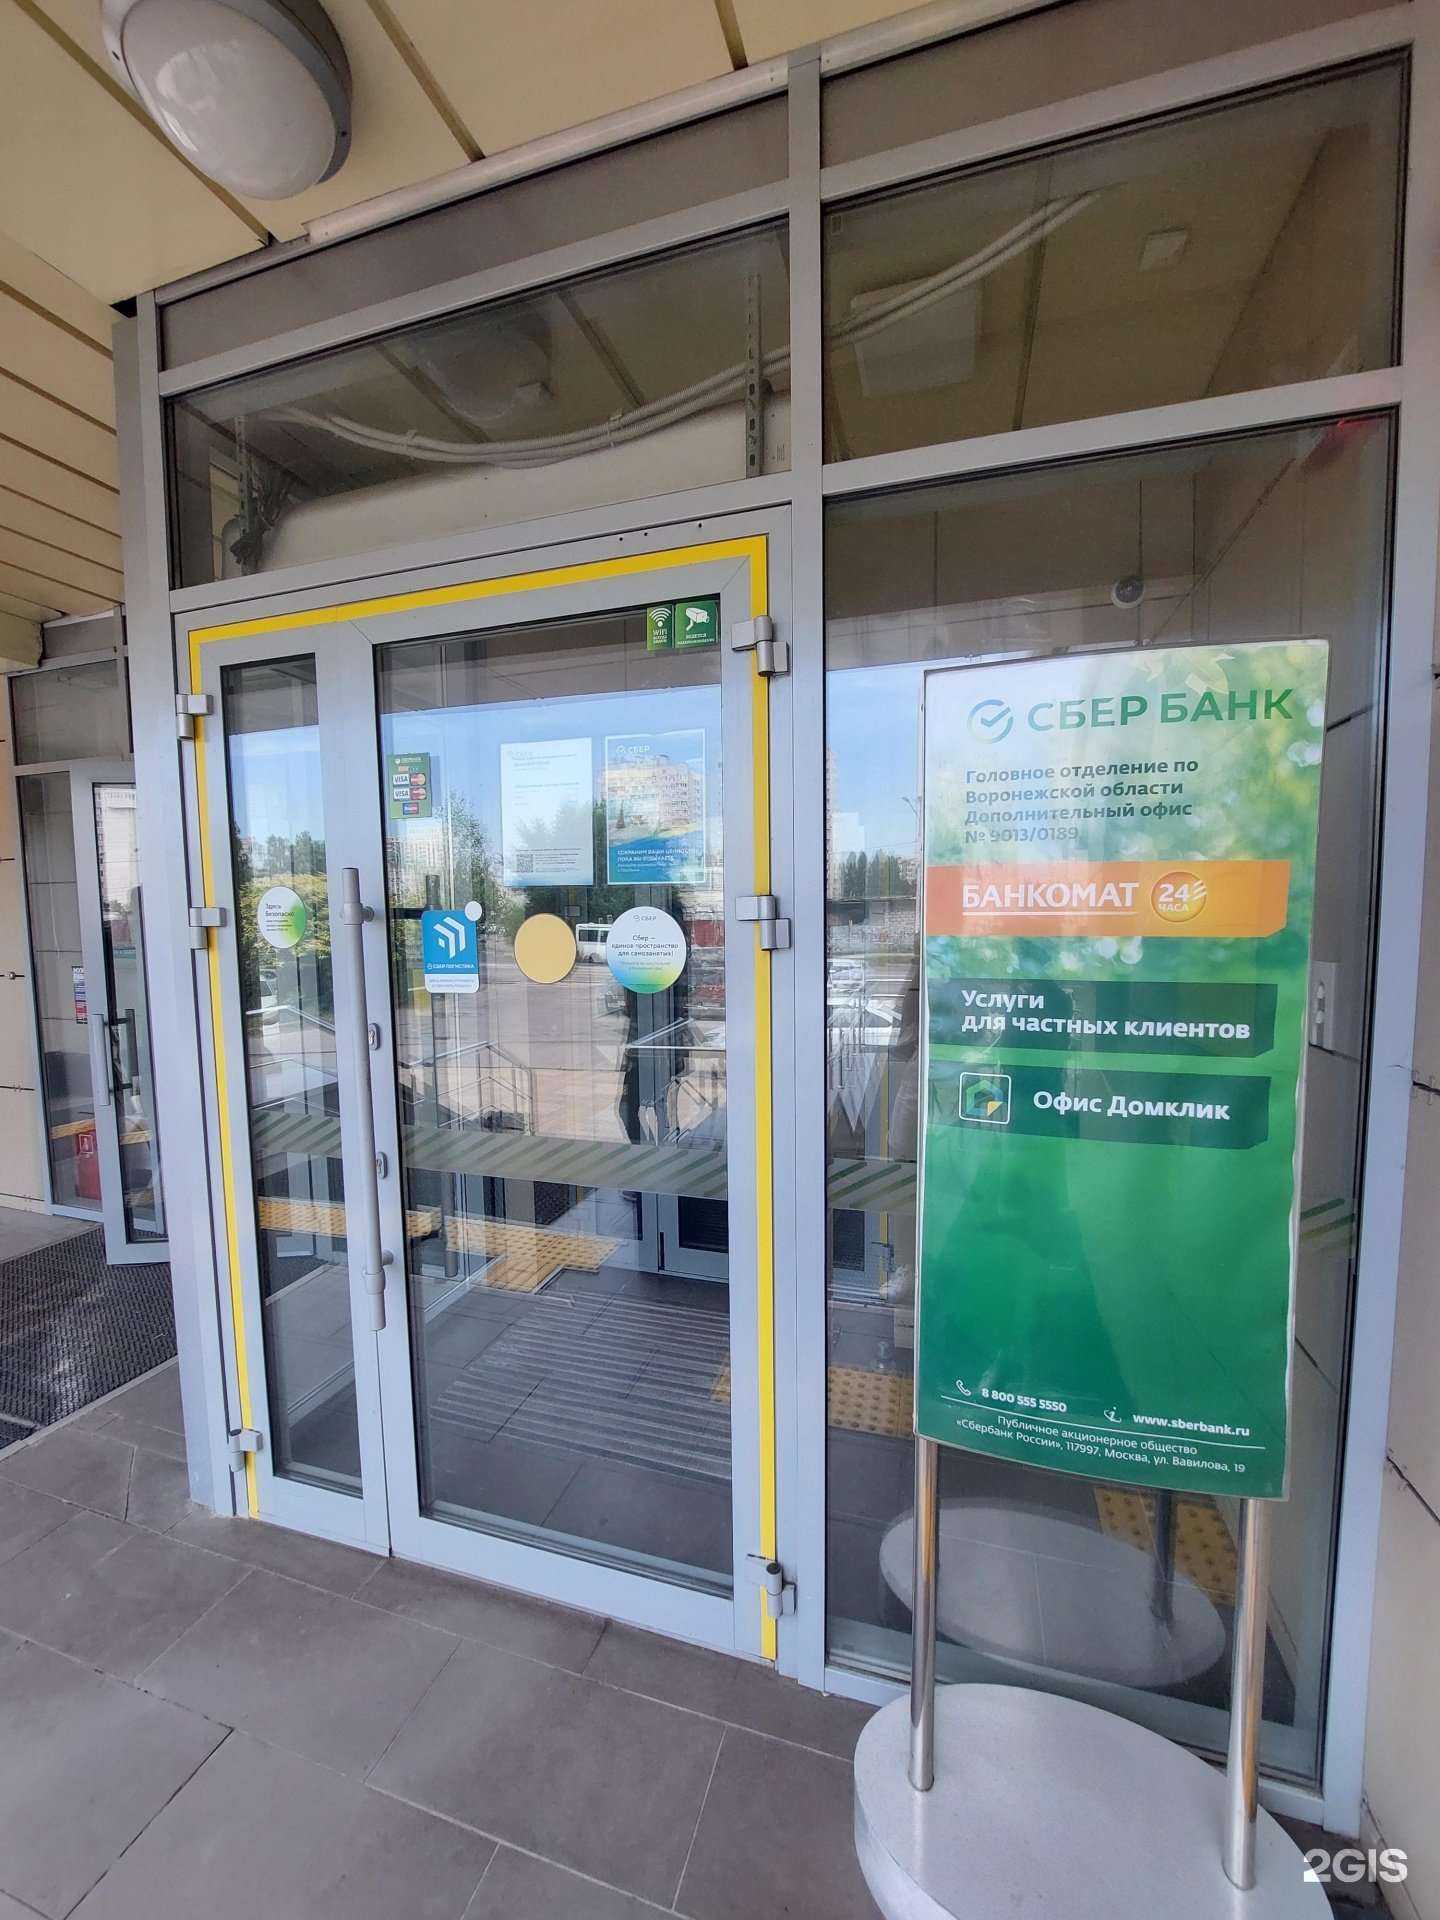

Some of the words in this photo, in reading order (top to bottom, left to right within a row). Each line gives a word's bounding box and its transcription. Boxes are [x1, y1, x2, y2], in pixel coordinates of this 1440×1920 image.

[1028, 694, 1148, 732] СБЕР
[1160, 688, 1294, 724] БАНК
[966, 766, 1055, 784] Головное
[1060, 760, 1169, 780] отделение
[1173, 758, 1199, 773] по
[966, 783, 1094, 805] Воронежской
[1100, 780, 1183, 798] области
[965, 803, 1135, 826] Дополнительный
[1140, 802, 1193, 820] офис
[990, 825, 1079, 844] 9013/0189
[962, 880, 1140, 910] БАНКОМАТ
[1158, 882, 1189, 903] 24
[1158, 903, 1189, 913] ЧАСА
[961, 989, 1045, 1013] Услуги
[961, 1014, 1006, 1032] для
[1012, 1017, 1118, 1035] частных
[1124, 1020, 1251, 1039] клиентов
[1033, 1091, 1102, 1115] Офис
[1107, 1095, 1230, 1121] Домклик
[981, 1388, 990, 1398] 8
[991, 1390, 1015, 1403] 800
[1016, 1395, 1037, 1408] 555
[1038, 1399, 1067, 1413] 5550
[997, 1416, 1059, 1436] Публичное
[1061, 1429, 1138, 1448] акционерное
[1140, 1440, 1198, 1455] общество
[1132, 1413, 1250, 1437] www.sberbank.ru
[956, 1419, 1014, 1439] «Сбербанк
[1016, 1431, 1064, 1450] России»,
[1066, 1441, 1101, 1457] 117997,
[1104, 1448, 1151, 1464] Москва,
[1153, 1455, 1169, 1466] ул.
[1172, 1456, 1231, 1473] Вавилова,
[1234, 1463, 1246, 1473] 19
